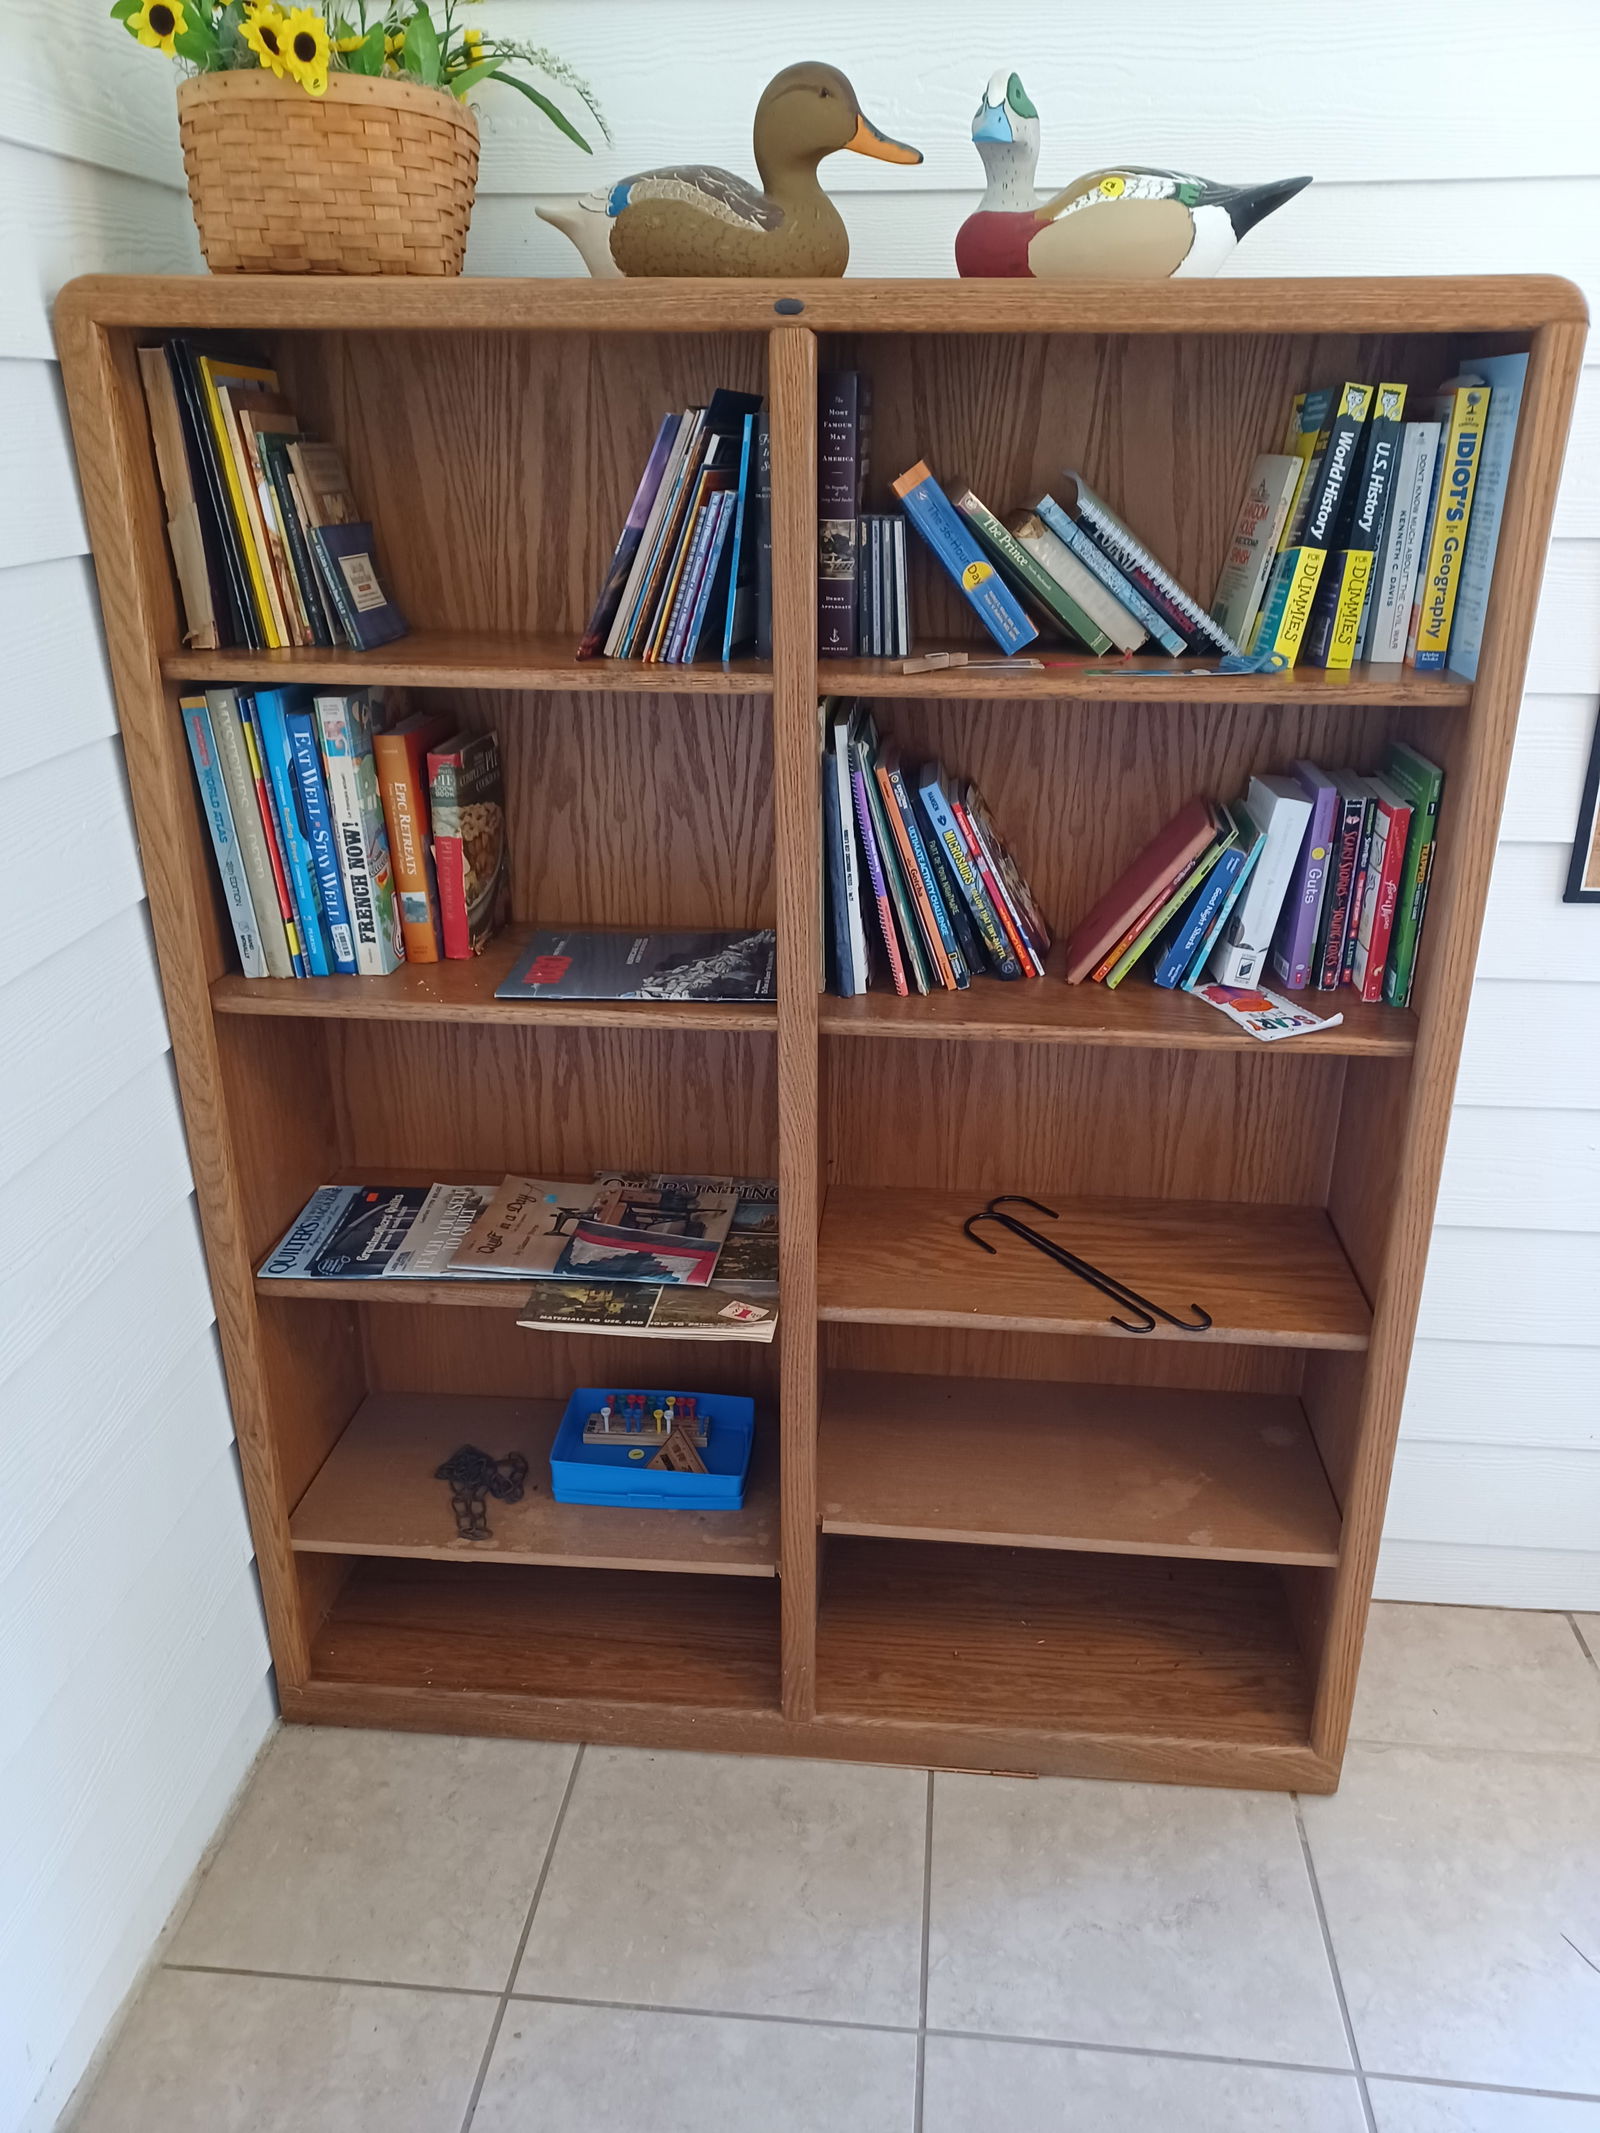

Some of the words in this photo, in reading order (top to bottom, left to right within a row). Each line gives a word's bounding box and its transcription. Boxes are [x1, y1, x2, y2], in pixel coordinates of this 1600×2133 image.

[1329, 431, 1354, 482] World
[1372, 442, 1391, 472] U.S.
[1416, 454, 1428, 483] DON'T
[1446, 432, 1478, 522] IDIOT'S
[1310, 479, 1341, 540] History
[1358, 472, 1384, 532] History
[1412, 485, 1424, 514] KNOW
[926, 504, 942, 523] The
[967, 564, 984, 585] Day
[982, 515, 1002, 538] The
[1000, 535, 1029, 566] Prince
[1392, 510, 1406, 562] KENNETH
[1408, 516, 1419, 545] MUCH
[1307, 553, 1320, 562] FOR
[1355, 555, 1368, 563] FOR
[1402, 548, 1414, 582] ABOUT
[1284, 564, 1318, 642] DUMMIES
[1386, 577, 1396, 607] DAVIS
[1398, 584, 1408, 603] THE
[1426, 537, 1459, 638] Geography
[1338, 566, 1366, 646] DUMMIES
[1395, 604, 1404, 630] CIVIL
[1392, 631, 1401, 650] WAR
[219, 700, 250, 808] MYSTERIES
[294, 732, 312, 766] EAT
[302, 768, 321, 820] WELL
[394, 782, 408, 811] EPIC
[928, 792, 939, 811] HANSEN
[204, 767, 220, 809] WORLD
[213, 810, 228, 844] ATLAS
[229, 876, 242, 907] EDITION
[284, 807, 294, 839] Reading
[290, 840, 299, 862] Street
[313, 830, 330, 868] STAY
[342, 822, 365, 870] NOW!
[400, 814, 417, 875] RETREATS
[928, 840, 939, 857] PART
[1342, 831, 1358, 860] SCARY
[908, 826, 924, 863] ULTIMATE
[918, 862, 935, 895] ACTIVITY
[930, 895, 949, 936] CHALLENGE
[943, 830, 974, 885] MICROSAURS
[971, 888, 984, 909] FOLLOW
[1336, 862, 1353, 896] STORIES
[1416, 844, 1430, 884] TRAPPED
[321, 872, 340, 921] WELL
[911, 868, 922, 897] Gotcha
[1212, 887, 1222, 905] Good
[1304, 868, 1322, 904] Guts
[1385, 880, 1397, 899] Flora
[350, 874, 376, 944] FRENCH
[1200, 904, 1213, 927] Night
[1330, 906, 1345, 940] YOUNG
[1381, 904, 1394, 930] Ulysses
[246, 934, 254, 950] RAND
[1185, 926, 1202, 949] Sharks
[1325, 941, 1342, 966] FOXES
[1246, 1014, 1317, 1032] SCARY
[413, 1240, 444, 1270] TEACH
[434, 1190, 470, 1236] YOURSELF
[452, 1208, 477, 1237] QUILT
[476, 1230, 502, 1254] Quilt
[507, 1194, 536, 1213] Day
[268, 1222, 320, 1274] QUILTER'S
[444, 1238, 462, 1250] TO
[539, 1314, 586, 1322] MATERIALS
